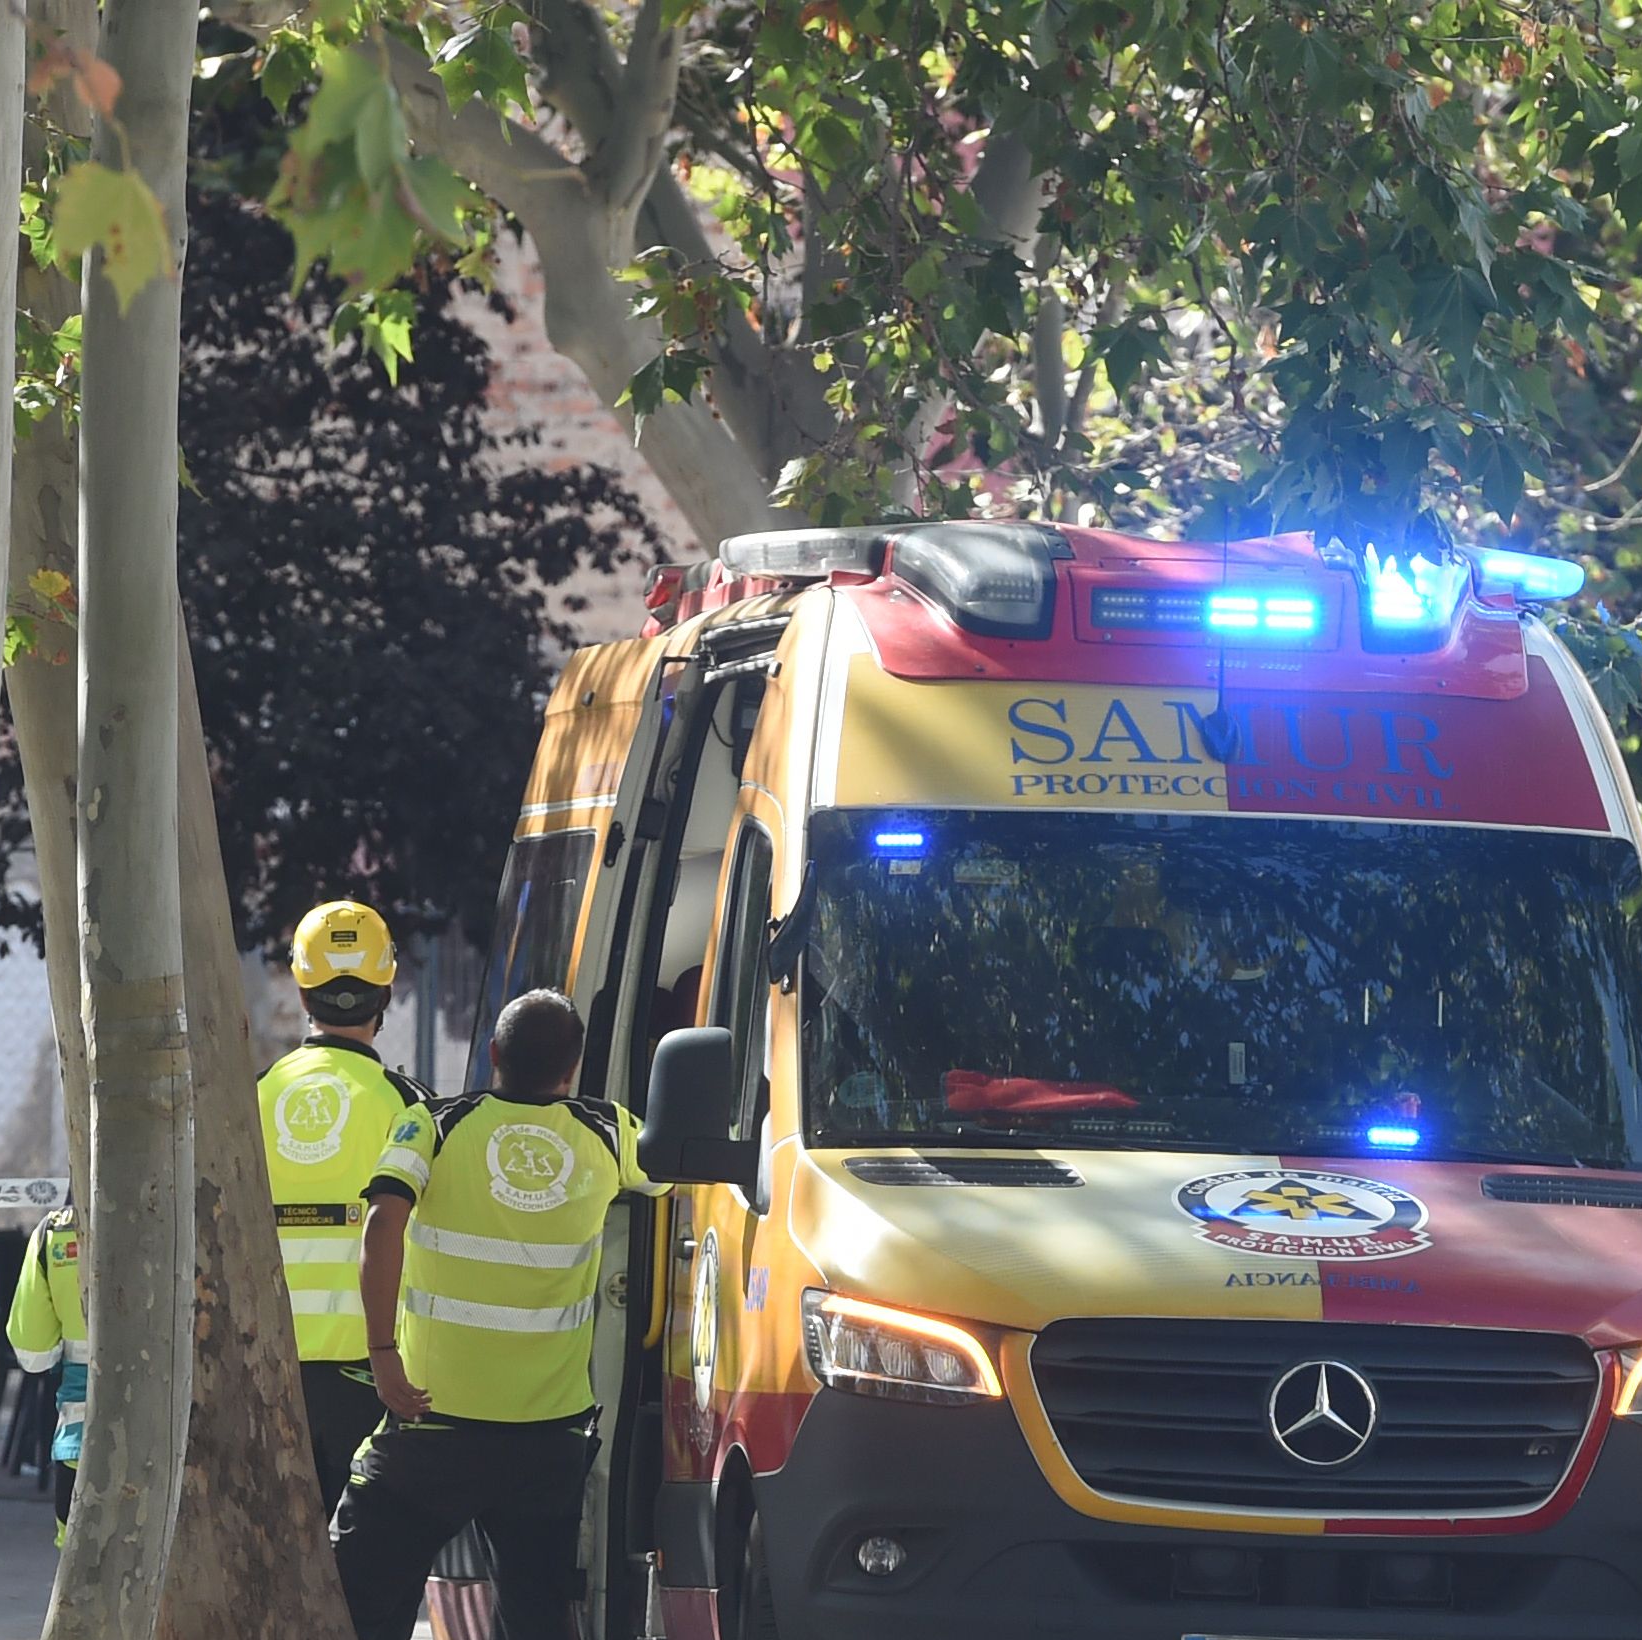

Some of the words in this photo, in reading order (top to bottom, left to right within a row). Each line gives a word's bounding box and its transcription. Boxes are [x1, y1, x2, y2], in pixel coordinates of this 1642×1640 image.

[1007, 698, 1454, 781] SAMUR
[1263, 1170, 1301, 1179] de
[1214, 1233, 1356, 1256] PROTECCION
[1362, 1239, 1414, 1255] CIVIL
